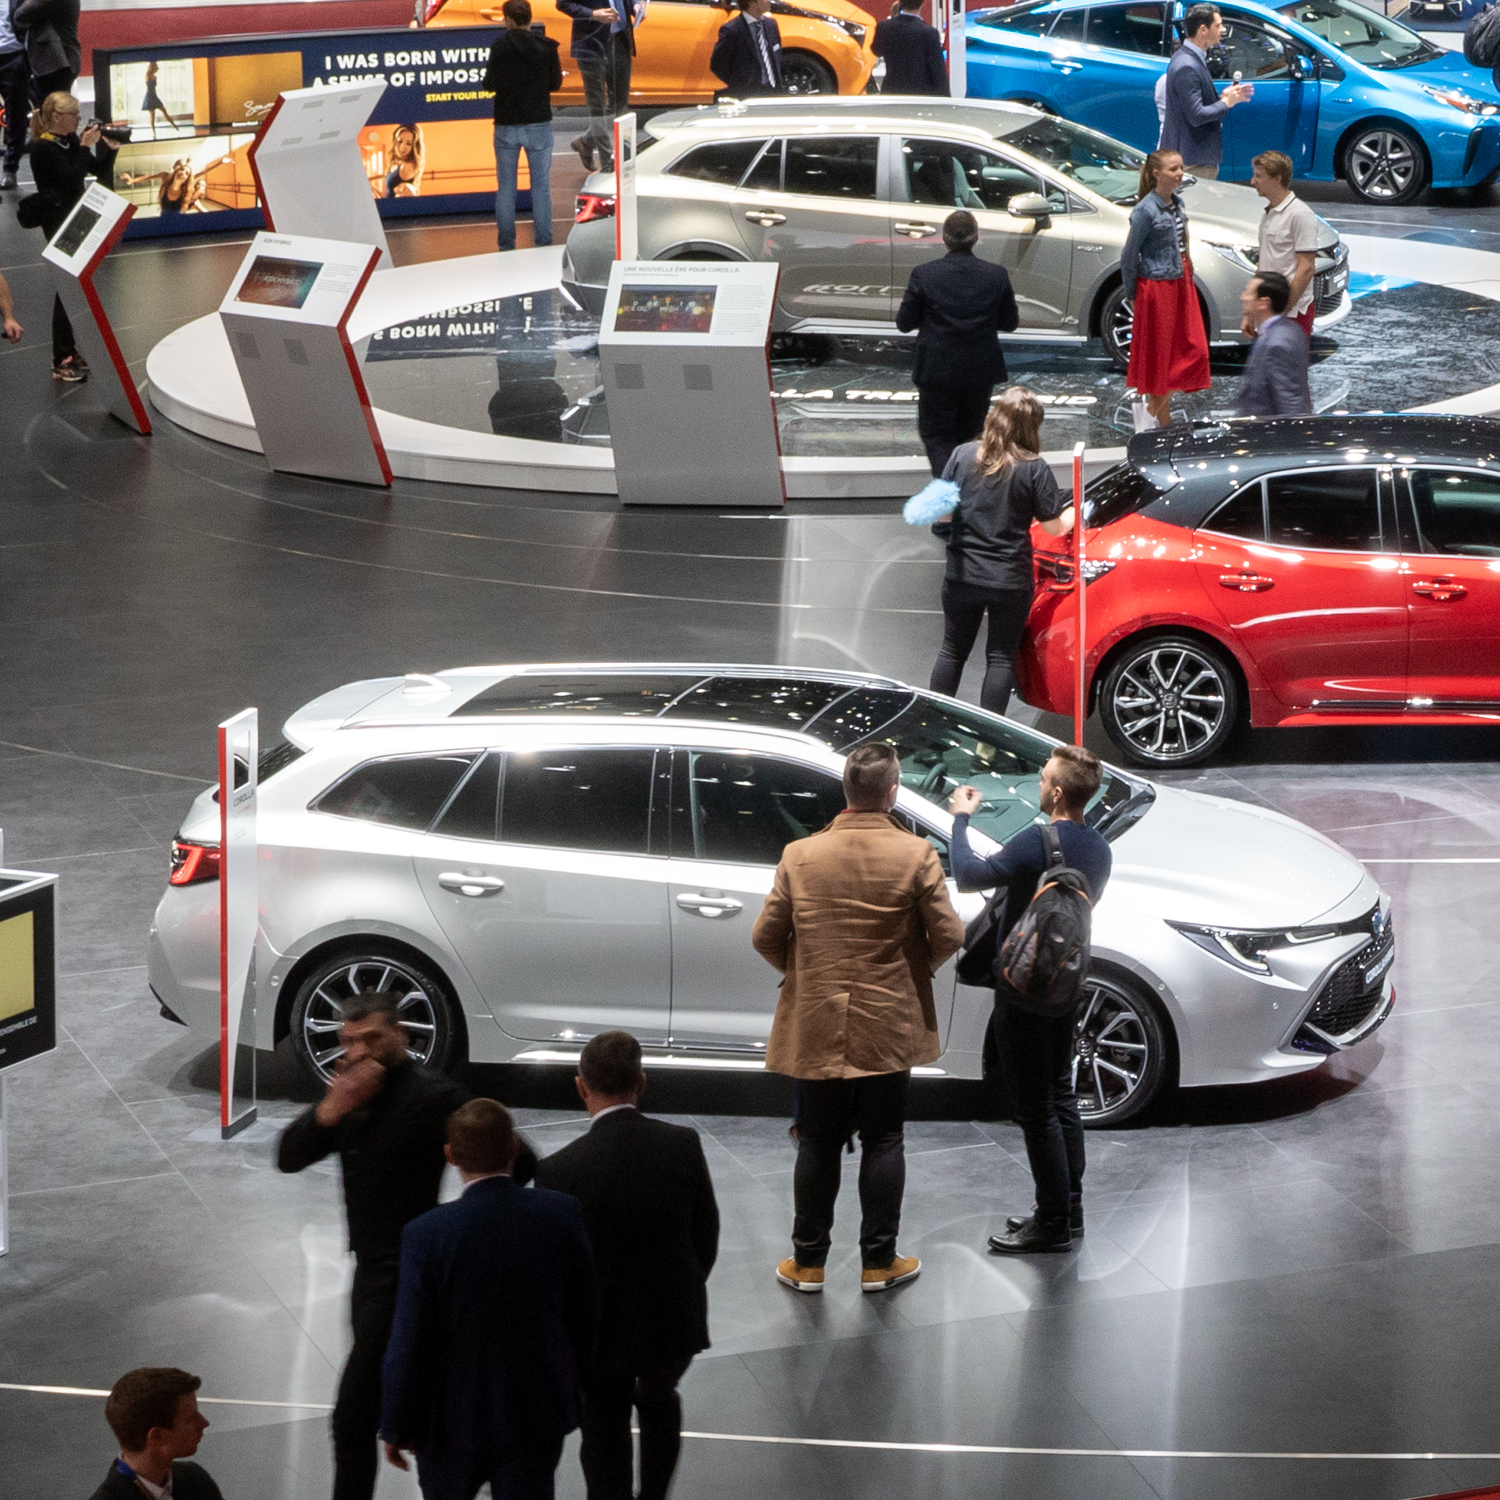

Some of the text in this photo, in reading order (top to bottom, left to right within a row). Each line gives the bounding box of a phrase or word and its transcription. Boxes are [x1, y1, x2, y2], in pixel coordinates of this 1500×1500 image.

[325, 47, 491, 70] I WAS BORN WITH
[390, 71, 416, 88] OF
[425, 92, 452, 103] START
[453, 91, 478, 102] YOUR
[689, 266, 707, 274] POUR
